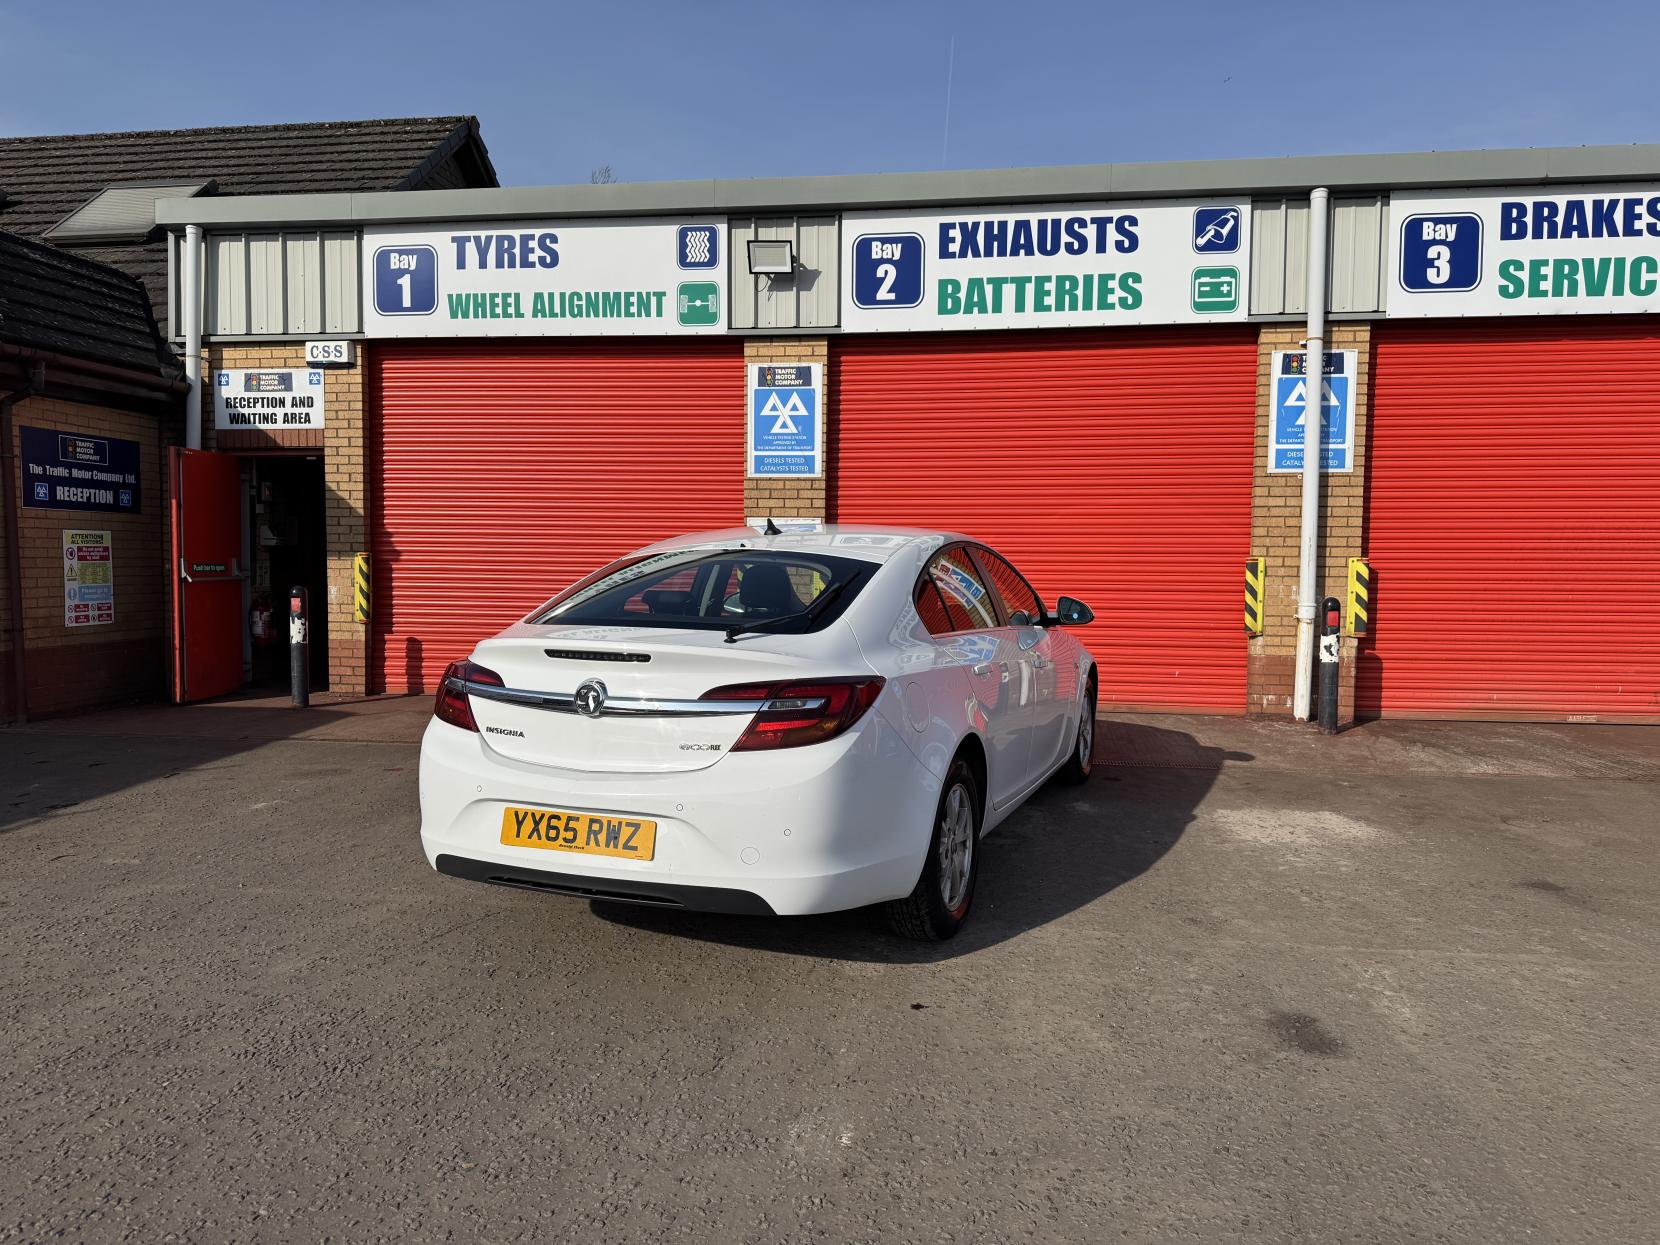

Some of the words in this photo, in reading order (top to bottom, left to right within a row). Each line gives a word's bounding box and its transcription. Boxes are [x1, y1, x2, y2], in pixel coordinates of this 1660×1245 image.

[938, 215, 1139, 259] EXHAUSTS
[1422, 221, 1457, 241] Bay
[390, 253, 416, 269] Bay
[451, 233, 559, 269] TYRES
[871, 241, 901, 260] Bay
[1426, 245, 1450, 284] 3
[397, 274, 411, 307] 1
[876, 264, 896, 300] 2
[937, 272, 1143, 315] BATTERIES
[447, 293, 525, 319] WHEEL
[532, 291, 666, 318] ALIGNMENT
[225, 397, 285, 408] RECEPTION
[291, 396, 314, 408] AND
[229, 413, 278, 424] WAITING
[283, 413, 311, 424] AREA
[28, 464, 43, 474] The
[46, 466, 70, 477] Traffic
[72, 468, 92, 480] Motor
[92, 471, 124, 483] Company
[125, 474, 136, 484] Ltd.
[56, 486, 114, 504] RECEPTION
[486, 726, 525, 738] INSIGNIA
[514, 811, 580, 844] YX65
[586, 818, 642, 851] RWZ
